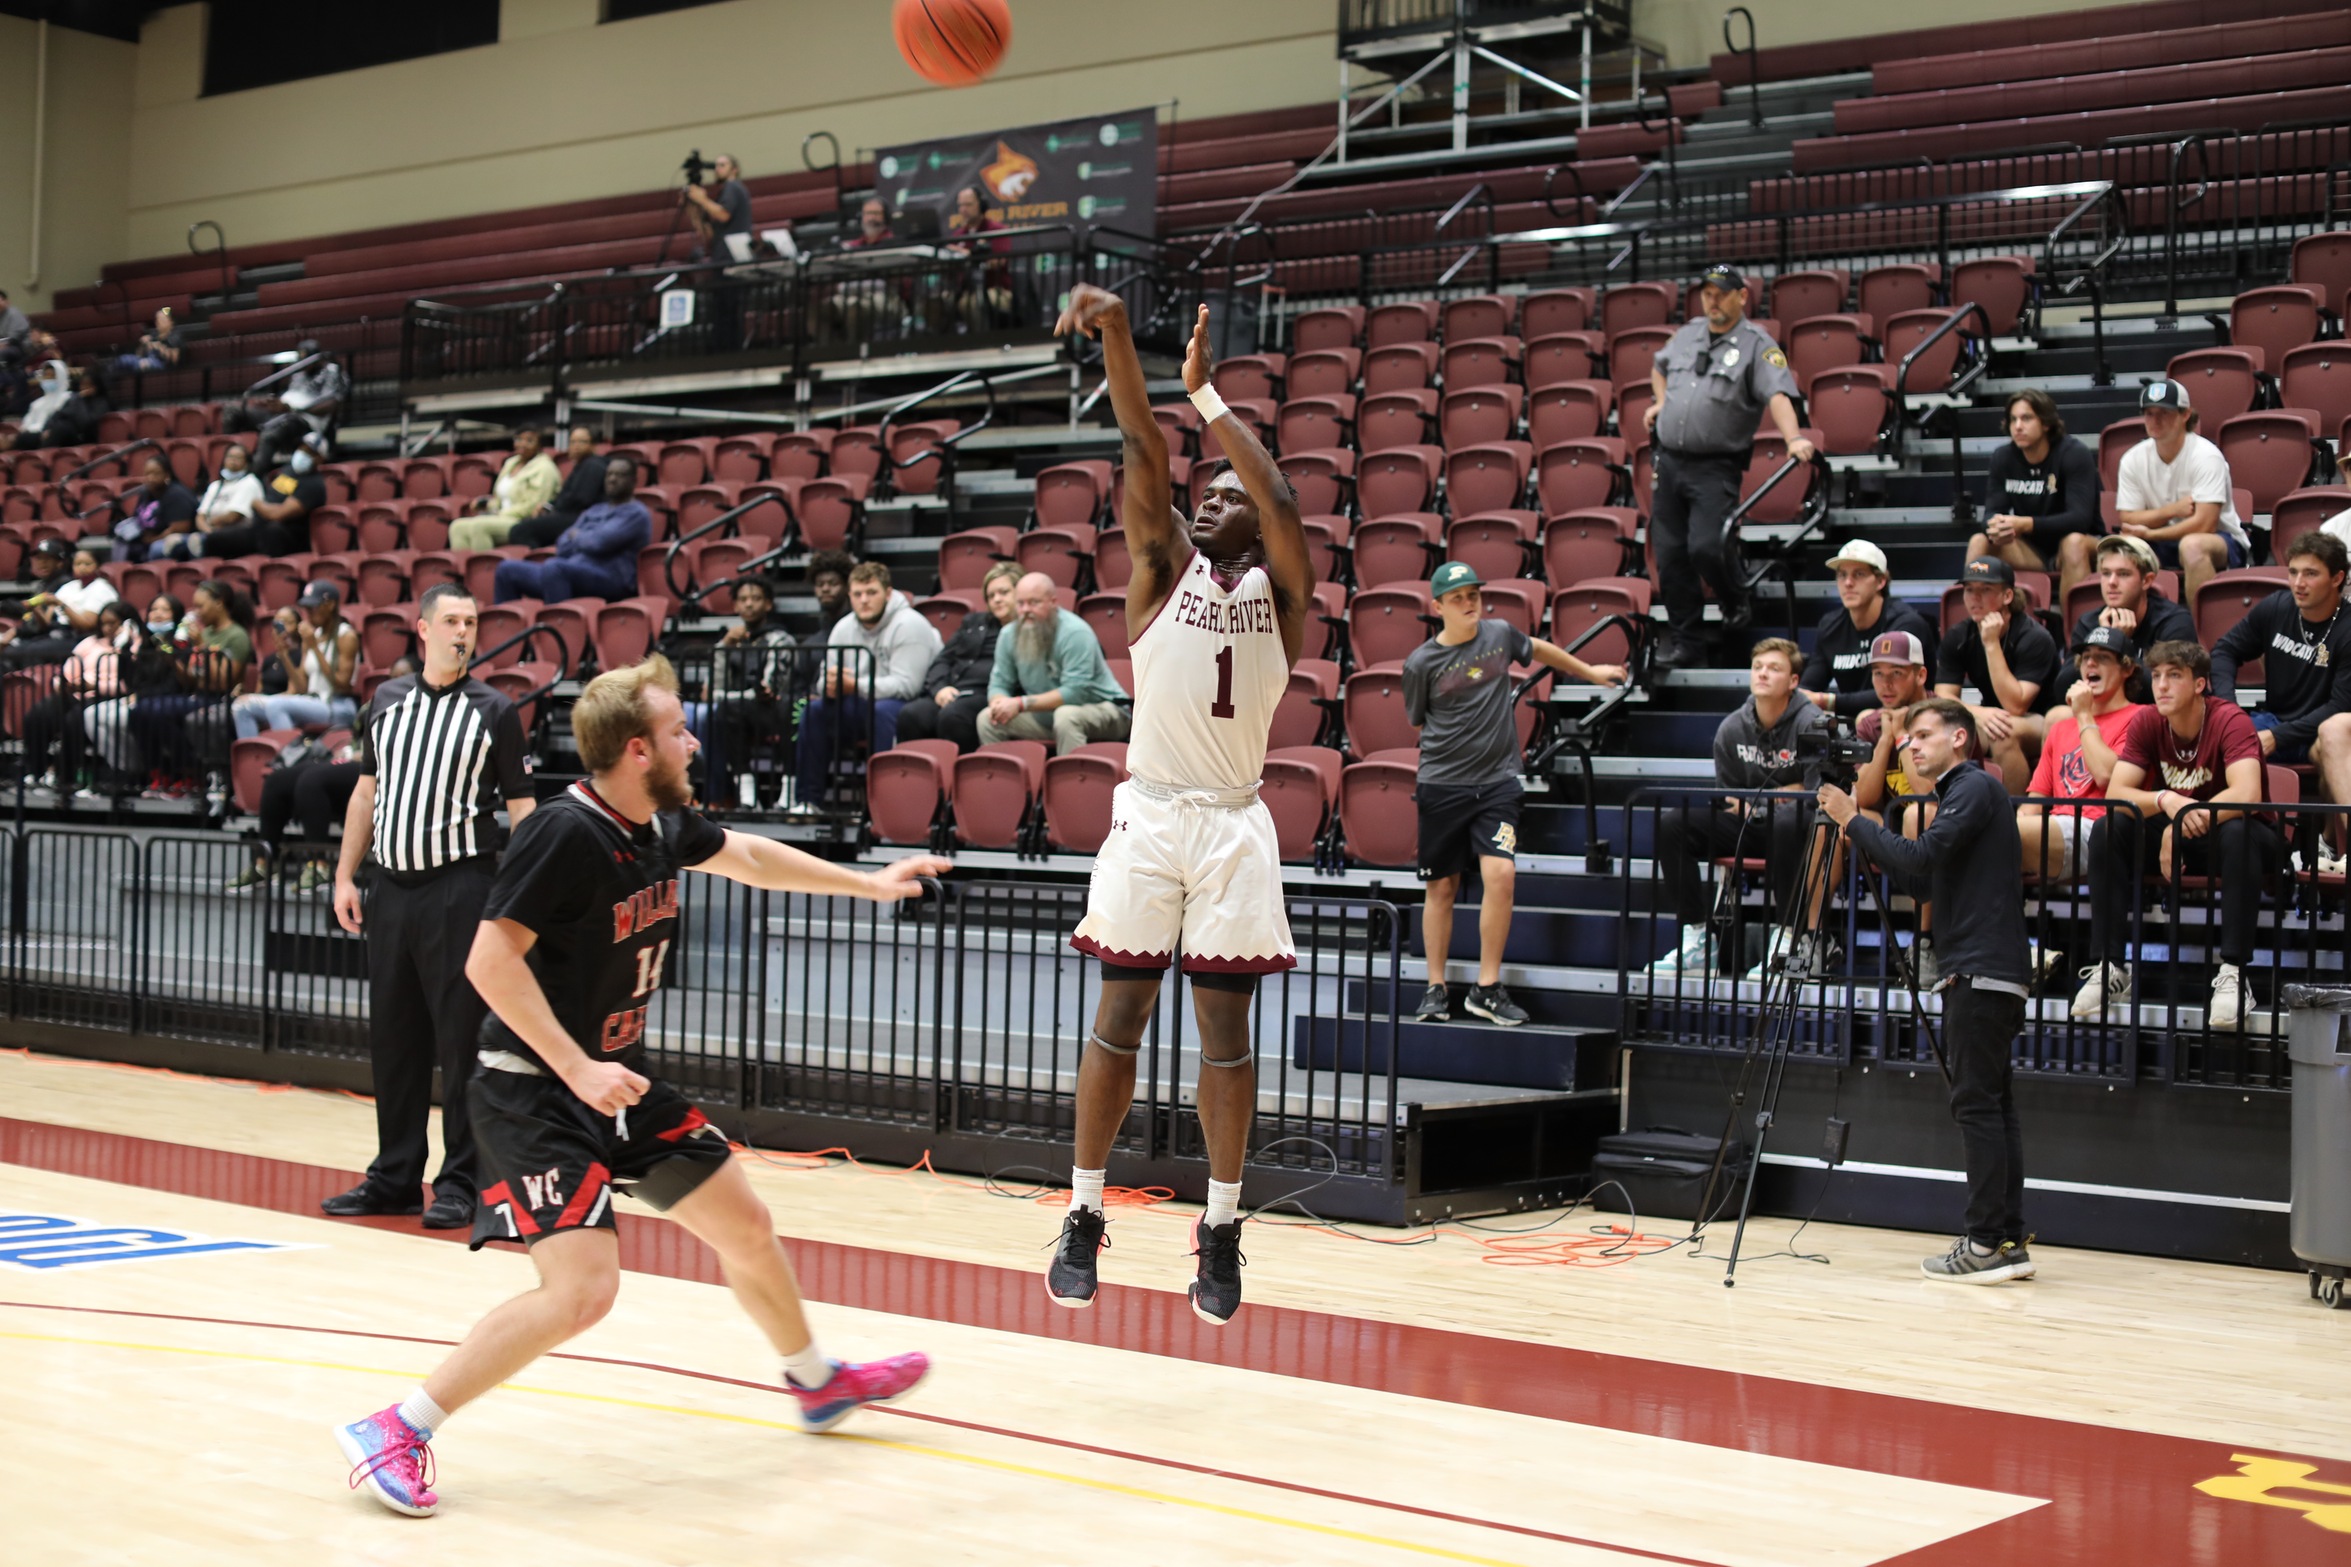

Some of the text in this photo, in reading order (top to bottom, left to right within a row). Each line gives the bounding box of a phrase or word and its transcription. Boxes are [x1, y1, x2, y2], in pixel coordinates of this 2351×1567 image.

[1007, 202, 1068, 220] RIVER
[1175, 590, 1273, 634] PEARL RIVER
[1211, 645, 1235, 719] 1
[522, 1167, 564, 1211] WC
